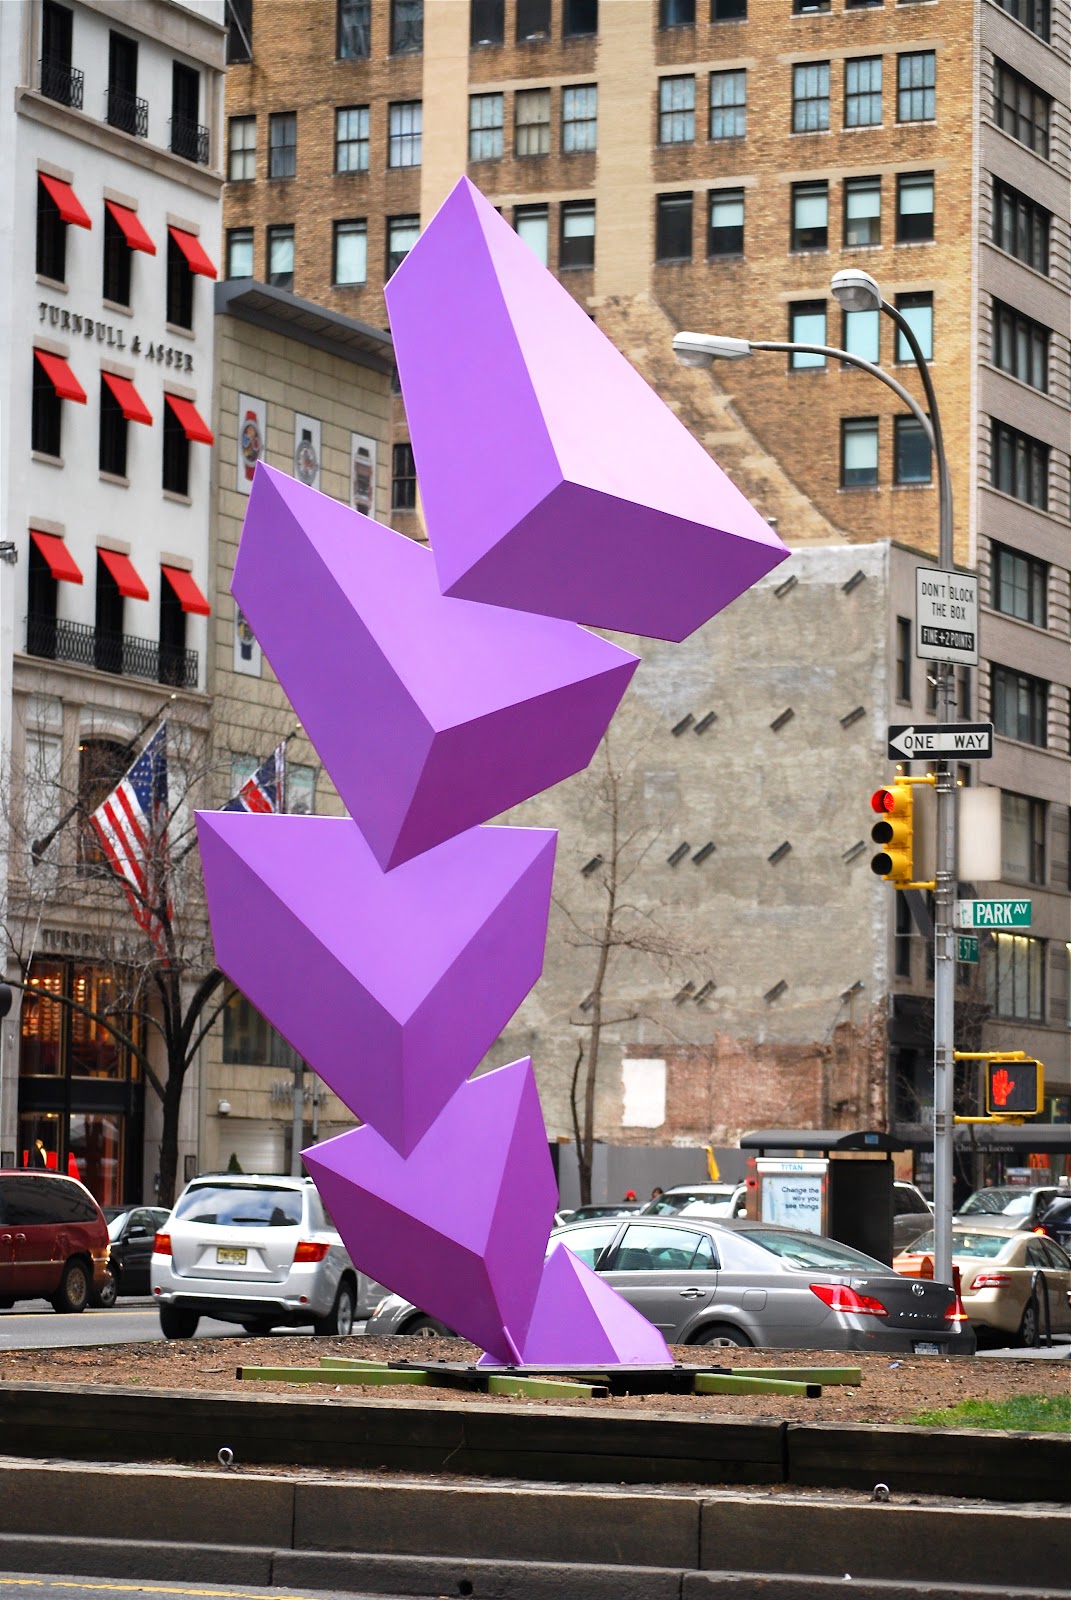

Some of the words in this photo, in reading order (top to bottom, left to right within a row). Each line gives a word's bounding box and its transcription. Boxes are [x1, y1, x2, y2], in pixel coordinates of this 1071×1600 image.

[38, 302, 126, 349] TURNBULL
[131, 335, 141, 353] &
[145, 341, 193, 372] ASSER
[921, 582, 945, 598] DON'T
[949, 586, 974, 603] BLOCK
[931, 602, 946, 617] THE
[950, 605, 966, 620] BOX
[923, 628, 938, 644] FINE
[950, 632, 973, 649] POINTS
[904, 735, 934, 749] ONE
[954, 734, 985, 748] WAY
[976, 903, 1013, 924] PARK
[1013, 903, 1028, 914] AV
[963, 938, 971, 959] 57
[781, 1186, 807, 1195] Change
[799, 1203, 819, 1211] things
